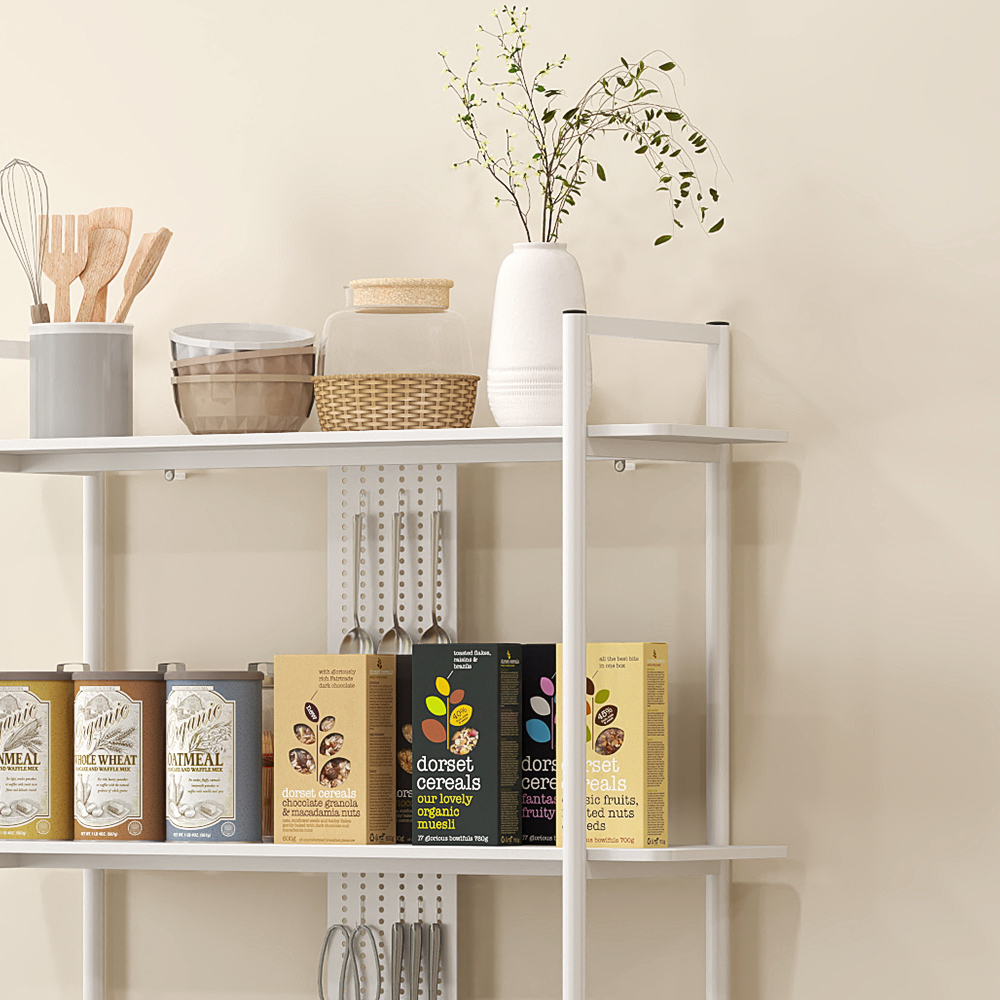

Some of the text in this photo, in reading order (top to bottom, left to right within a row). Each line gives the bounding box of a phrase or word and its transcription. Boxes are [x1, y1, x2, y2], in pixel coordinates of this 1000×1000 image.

[305, 704, 318, 721] new
[98, 755, 137, 765] WHEAT
[168, 752, 223, 766] OATMEAL
[416, 755, 475, 772] dorset
[521, 755, 557, 772] dors
[416, 774, 481, 790] cereals
[521, 777, 557, 790] cere
[281, 788, 356, 798] dorset cereals
[417, 794, 438, 804] our
[440, 793, 473, 806] lovely
[521, 794, 557, 804] fantas
[282, 799, 358, 809] chocolate granola
[604, 794, 639, 807] fruits,
[291, 808, 340, 817] macadamia
[341, 809, 361, 817] nuts
[417, 806, 460, 819] organic
[521, 806, 556, 820] fruity
[608, 809, 635, 818] nuts
[417, 819, 456, 830] muesli
